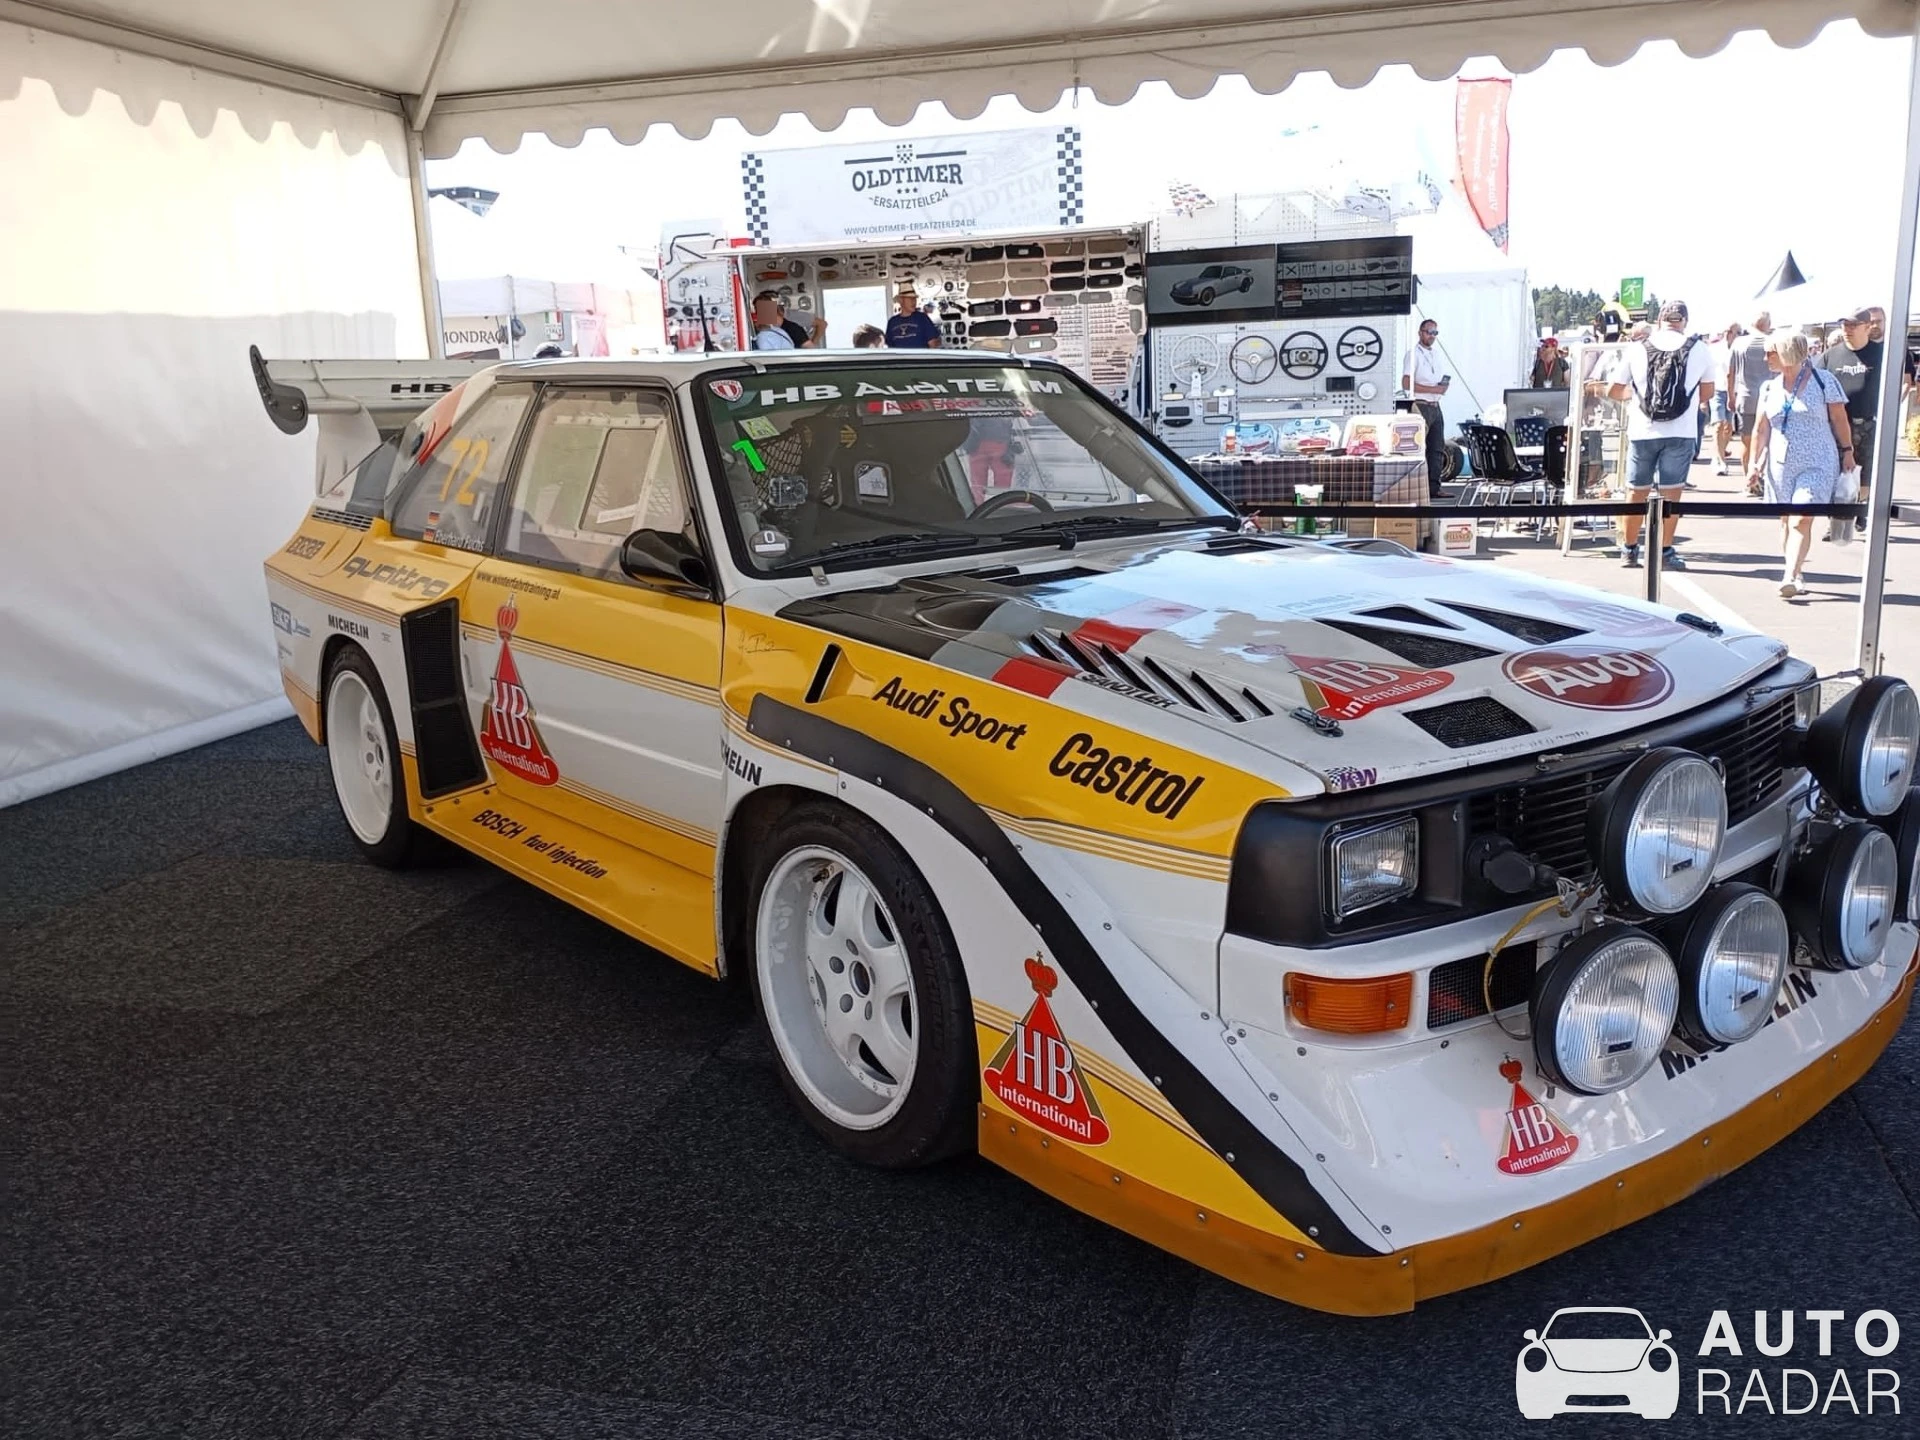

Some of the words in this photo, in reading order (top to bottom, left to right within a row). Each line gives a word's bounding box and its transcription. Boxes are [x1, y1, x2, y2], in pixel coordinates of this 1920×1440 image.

[852, 163, 963, 192] OLDTIMER
[844, 218, 977, 235] WWW.OLDTIMER-ERSATZTEILE24.DE
[390, 383, 453, 393] HB
[760, 384, 842, 406] HB
[948, 378, 1063, 395] TEAM
[439, 436, 489, 507] 72
[732, 440, 766, 473] 1
[343, 555, 450, 598] quattro
[327, 614, 370, 640] MICHELIN
[1288, 659, 1402, 697] HB
[1333, 677, 1443, 719] international
[490, 678, 534, 751] HB
[871, 676, 947, 720] Audi
[938, 696, 1028, 752] Sport
[490, 745, 551, 780] international
[1049, 732, 1206, 821] Castrol
[472, 809, 524, 839] BOSCH
[522, 833, 555, 857] fuel
[548, 843, 608, 880] injection
[1014, 1021, 1075, 1105] HB
[999, 1080, 1092, 1139] international
[1506, 1101, 1554, 1153] HB
[1508, 1139, 1573, 1173] international
